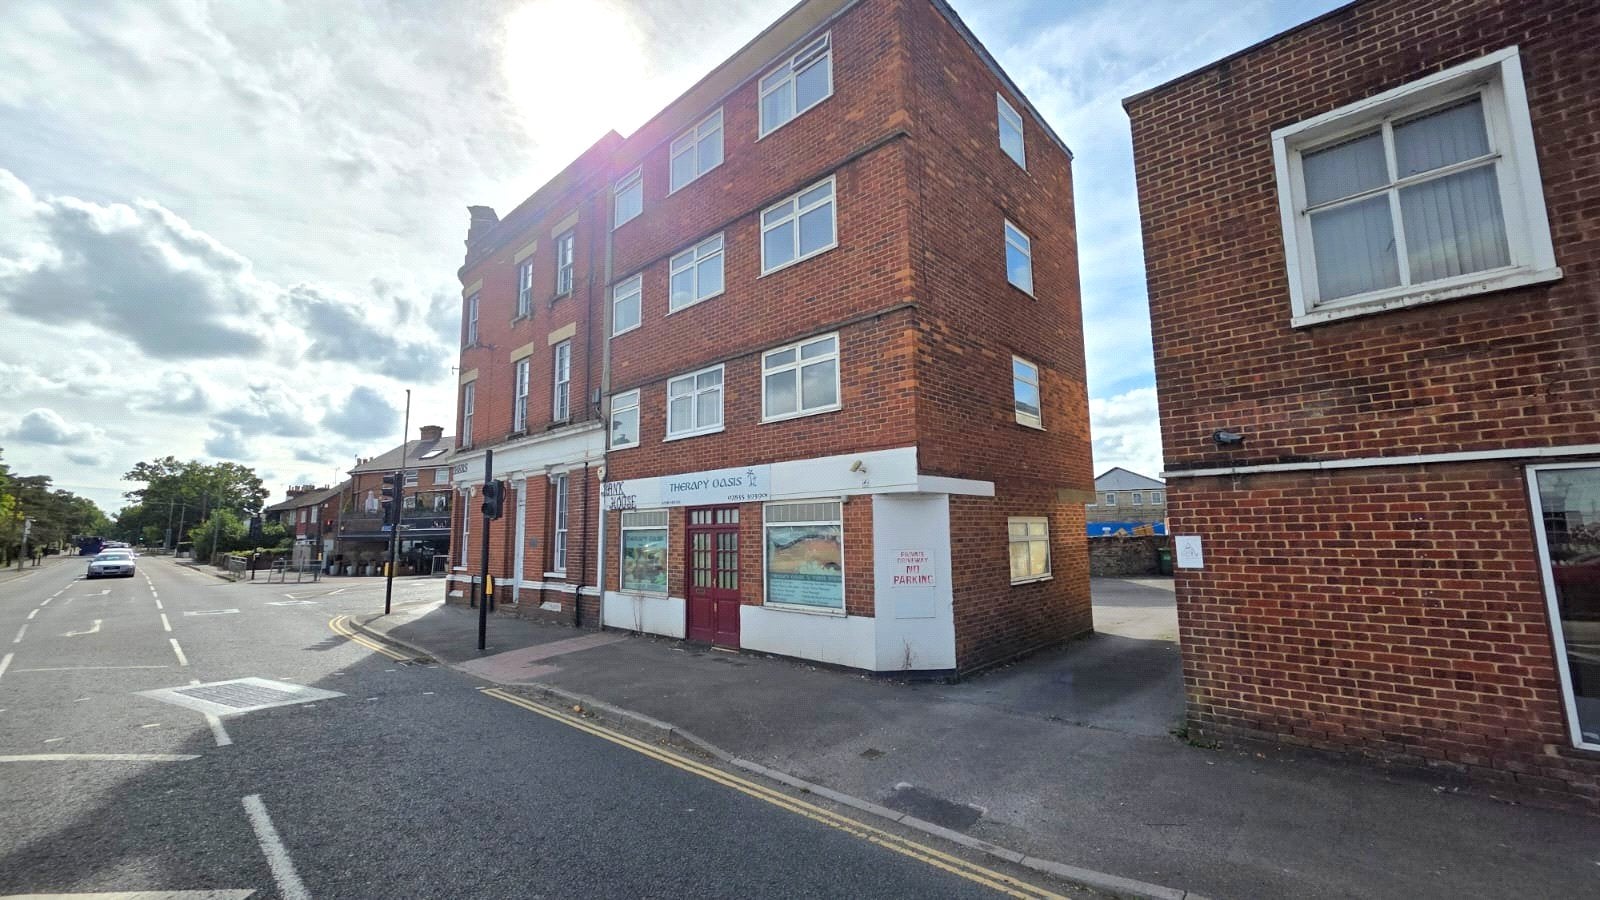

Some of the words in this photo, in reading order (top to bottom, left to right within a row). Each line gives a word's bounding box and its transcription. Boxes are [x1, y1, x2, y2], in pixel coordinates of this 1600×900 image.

[669, 479, 710, 493] THERAPY
[712, 476, 743, 489] OASIS
[906, 565, 920, 574] NO
[893, 575, 934, 585] PARKING
